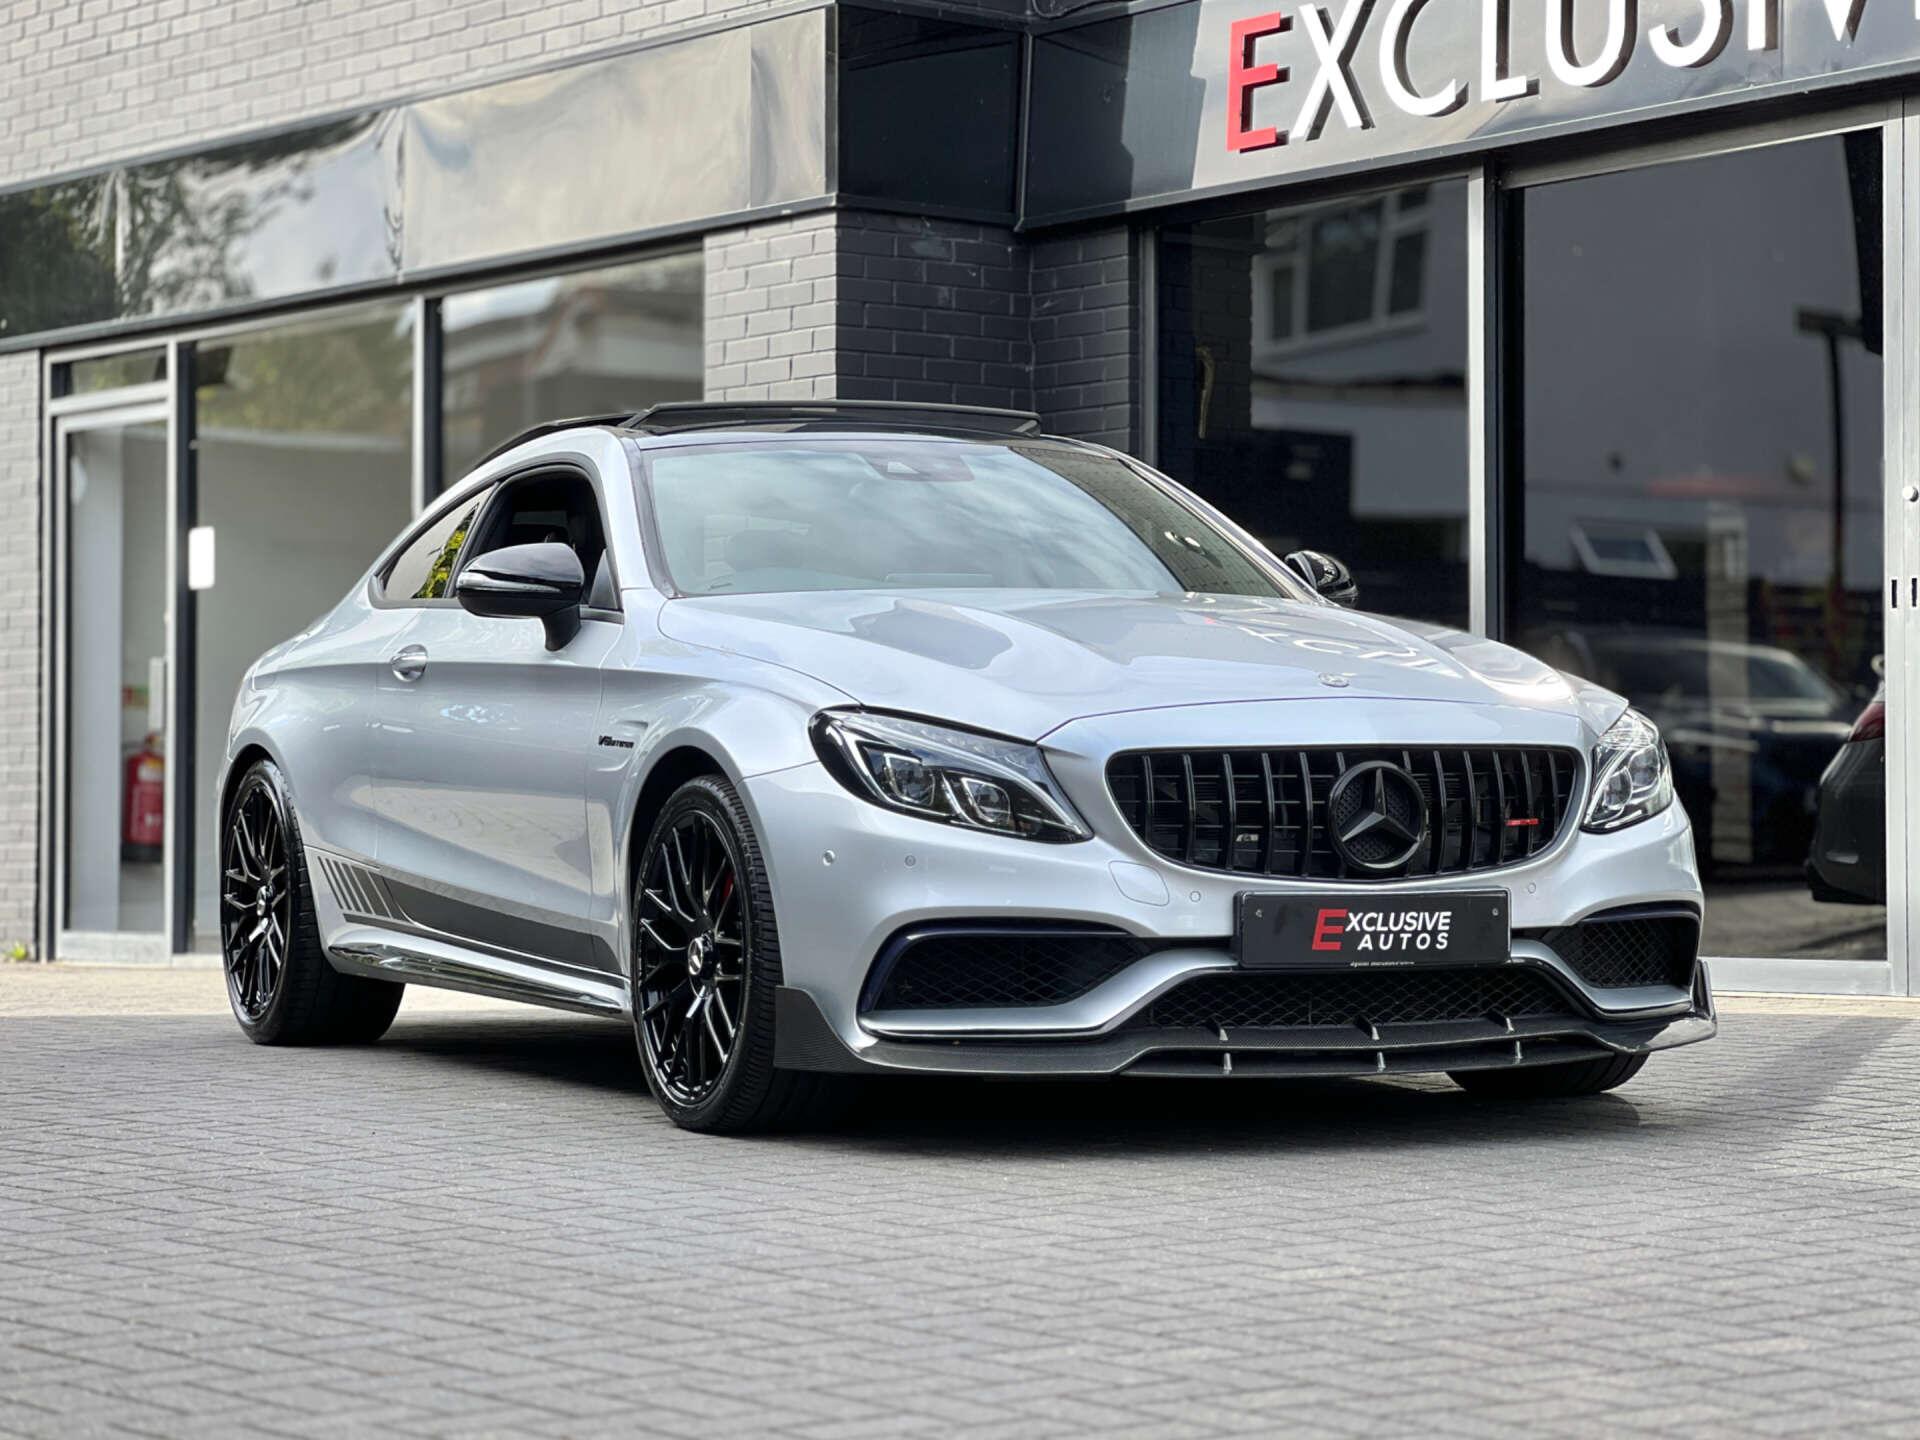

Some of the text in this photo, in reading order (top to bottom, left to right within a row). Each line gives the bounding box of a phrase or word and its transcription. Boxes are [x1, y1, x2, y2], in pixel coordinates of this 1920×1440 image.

[1226, 0, 1920, 153] EXCLU
[1311, 908, 1452, 951] EXCLUSIVE
[1356, 932, 1450, 951] AUTOS
